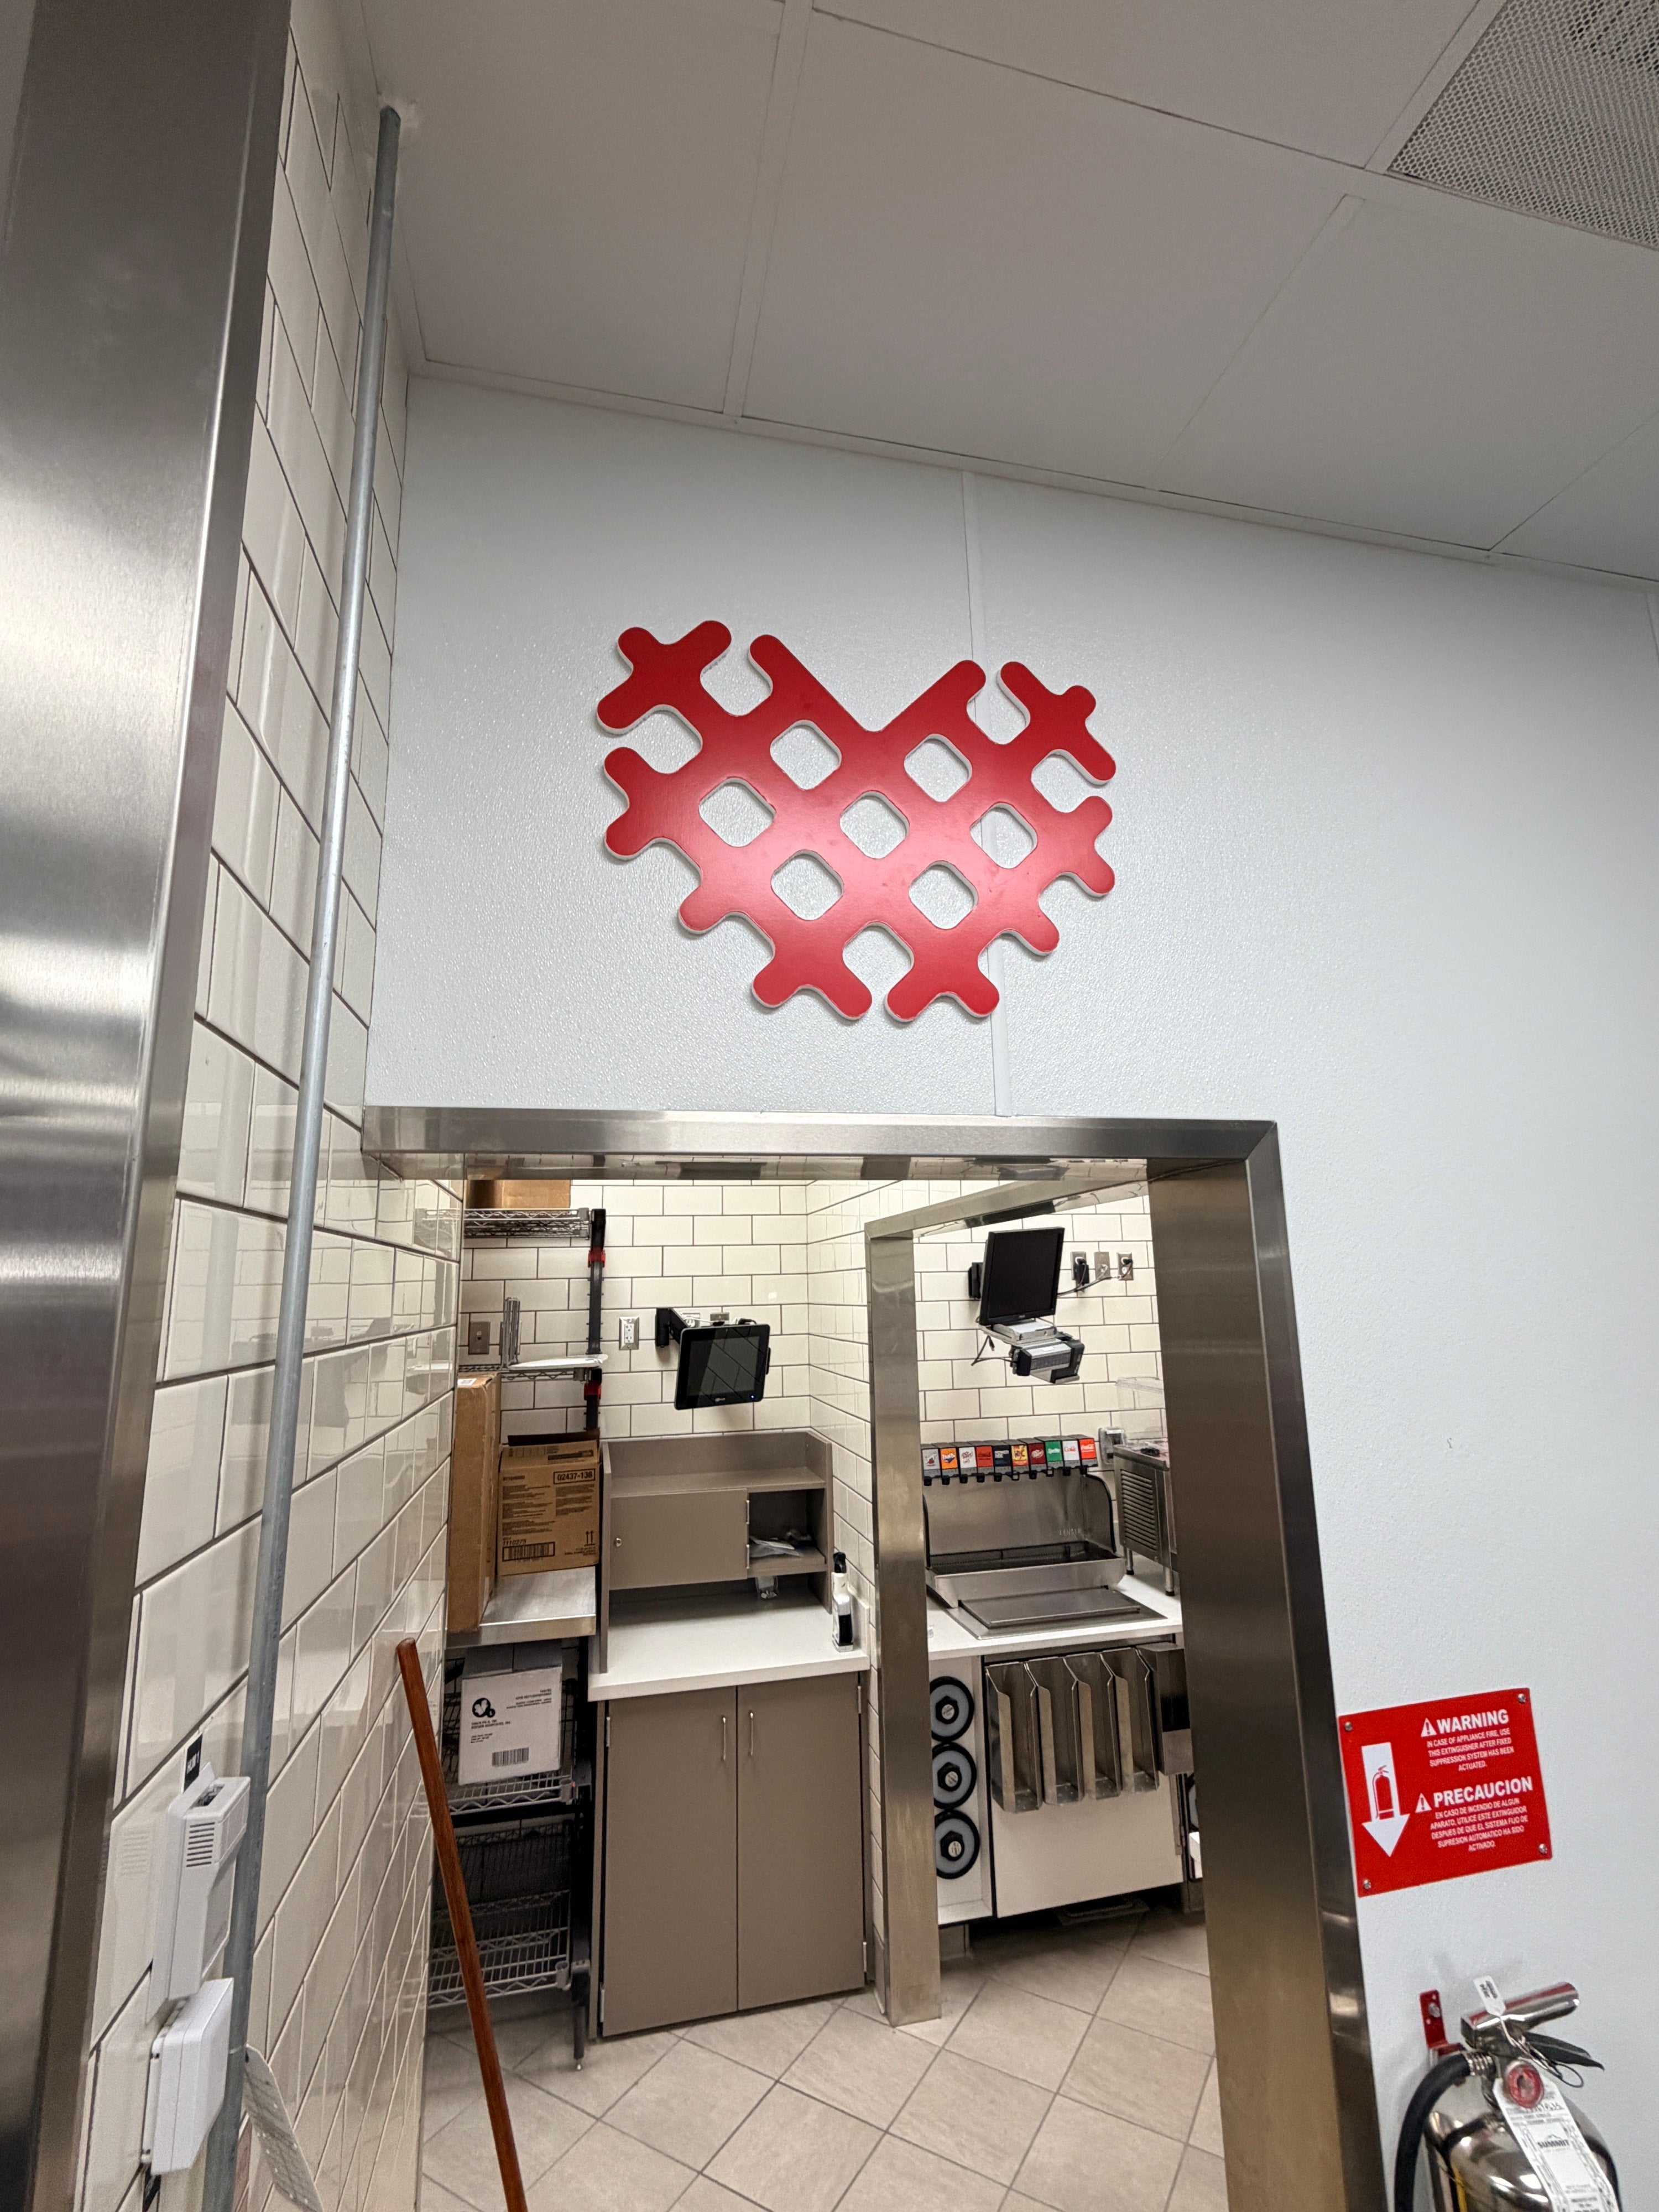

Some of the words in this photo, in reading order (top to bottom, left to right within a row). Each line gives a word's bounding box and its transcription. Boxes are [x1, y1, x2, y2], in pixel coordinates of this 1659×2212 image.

[1436, 1709, 1509, 1734] WARNING
[1433, 1738, 1448, 1746] CASE
[1457, 1732, 1485, 1743] APPLIANCE
[1500, 1727, 1511, 1736] USE
[1428, 1749, 1441, 1757] THIS
[1441, 1742, 1479, 1756] EXTINGUISHER
[1479, 1739, 1496, 1749] AFTER
[1496, 1737, 1512, 1746] FIXED
[1429, 1754, 1466, 1767] SUPPRESSION
[1467, 1750, 1488, 1760] SYSTEM
[1488, 1748, 1499, 1757] HAS
[1500, 1746, 1515, 1755] BEEN
[1458, 1760, 1488, 1772] ACTUATED.
[1433, 1776, 1533, 1808] PRECAUCION
[1444, 1809, 1459, 1818] CASO
[1459, 1807, 1467, 1815] DE
[1467, 1802, 1493, 1813] INCENDIO
[1493, 1801, 1501, 1809] DE
[1457, 1814, 1477, 1825] UTILICE
[1478, 1812, 1492, 1821] ESTE
[1492, 1806, 1527, 1818] EXTINGUIDOR
[1431, 1828, 1457, 1840] DESPUES
[1457, 1826, 1465, 1834] DE
[1465, 1824, 1477, 1833] QUE
[1485, 1819, 1507, 1829] SISTEMA
[1508, 1816, 1520, 1825] FIJO
[1520, 1814, 1528, 1823] DE
[1437, 1836, 1468, 1848] SUPRESION
[1468, 1829, 1503, 1843] AUTOMATICO
[1503, 1827, 1511, 1835] HA
[1511, 1825, 1525, 1834] SIDO
[1468, 1840, 1496, 1852] ACTIVADO.
[1537, 2139, 1570, 2148] SUMMIT
